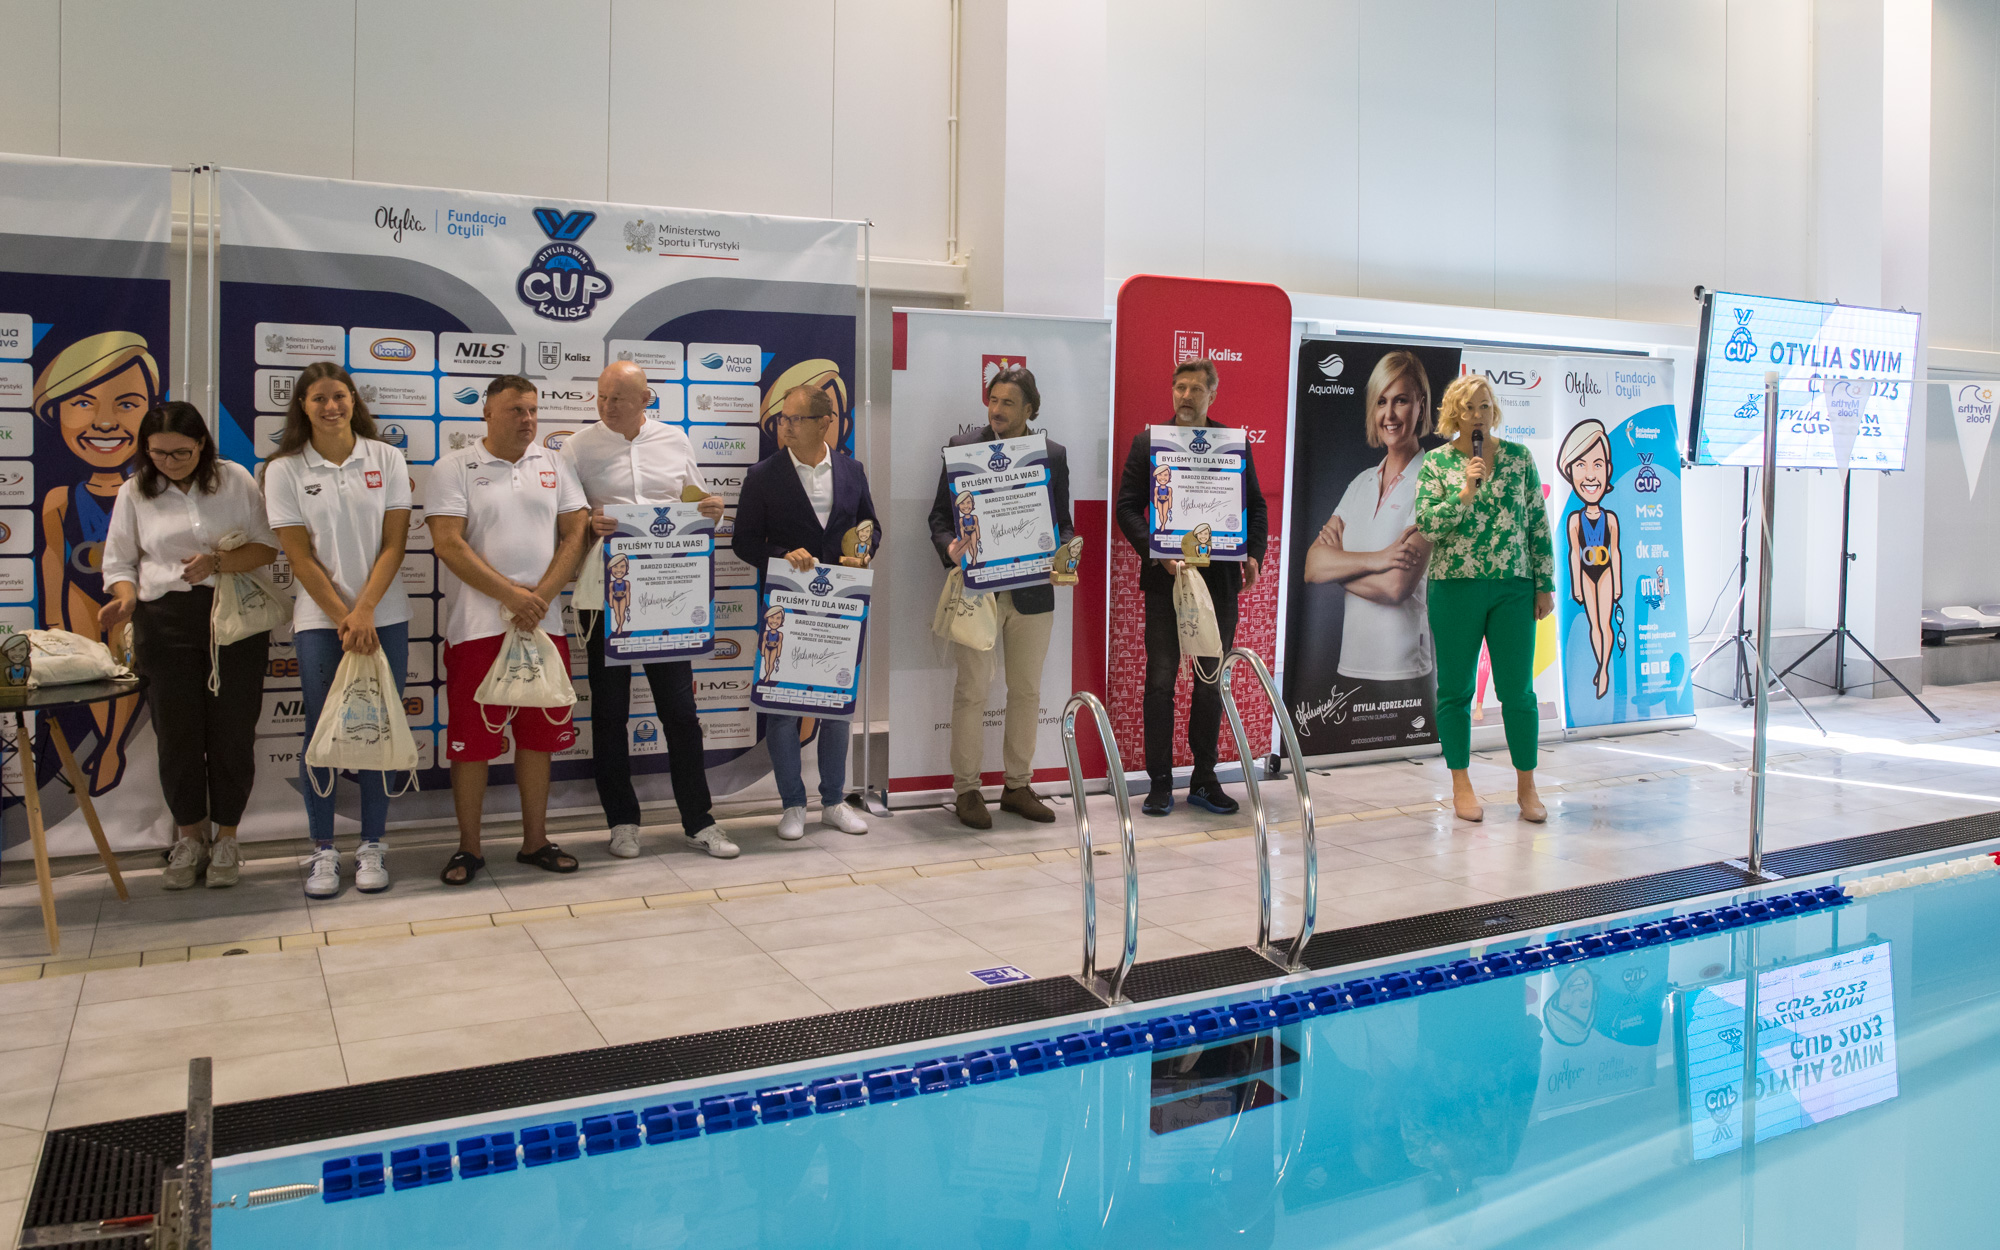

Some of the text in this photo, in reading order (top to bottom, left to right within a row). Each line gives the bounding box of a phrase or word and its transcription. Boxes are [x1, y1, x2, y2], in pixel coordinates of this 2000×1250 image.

[447, 209, 507, 227] Fundacja
[374, 206, 426, 243] Otylia
[447, 223, 484, 239] Otylii
[658, 224, 721, 237] Ministerstwo
[658, 237, 740, 251] Sportu i Turystyki
[538, 246, 588, 265] OTYLIA SWIM
[523, 272, 607, 305] CUP
[538, 302, 587, 318] KALISZ
[0, 328, 19, 339] ua
[286, 336, 324, 344] Ministerstwo
[285, 343, 304, 352] Sportu
[310, 344, 337, 352] Turystyki
[377, 345, 411, 358] koral
[455, 342, 505, 358] NILS
[1726, 341, 1756, 363] CUP
[564, 352, 591, 362] Kalisz
[725, 356, 752, 365] Aqua
[1208, 348, 1243, 362] Kalisz
[1770, 341, 1902, 374] OTYLIA SWIM
[655, 359, 676, 367] Turystyki
[725, 364, 752, 373] Wave
[1615, 371, 1656, 387] Fundacja
[378, 386, 415, 394] Ministerstwo
[1308, 383, 1355, 396] AquaWave
[1565, 371, 1602, 407] Otylia
[1615, 385, 1641, 400] Otylii
[378, 393, 397, 402] Sportu
[402, 394, 427, 402] Turystyki
[541, 390, 584, 400] HMS
[713, 401, 729, 409] Sportu
[1779, 409, 1821, 422] TYLIA
[1505, 426, 1536, 437] Fundacja
[1791, 423, 1830, 435] CUP
[1857, 426, 1882, 437] 23
[702, 440, 746, 450] AQUAPARK
[1190, 443, 1211, 451] CUP
[989, 458, 1011, 469] CUP
[1161, 455, 1192, 463] BYLIŚMY
[704, 478, 742, 486] HMS
[961, 469, 1040, 488] BYLIŚMY TU DLA WAS!
[1636, 478, 1661, 491] CUP
[984, 496, 1005, 504] BARDZO
[650, 524, 675, 534] CUP
[617, 540, 703, 550] BYLIŚMY TU DLA WAS!
[810, 583, 833, 592] CUP
[776, 595, 858, 612] BYLIŚMY TU DLA WAS!
[714, 644, 737, 657] oral
[700, 681, 739, 691] HMS
[274, 701, 306, 716] NIL
[1353, 698, 1422, 712] OTYLIA JĘDRZEJCZAK
[934, 722, 952, 731] prze
[269, 753, 293, 763] TVP
